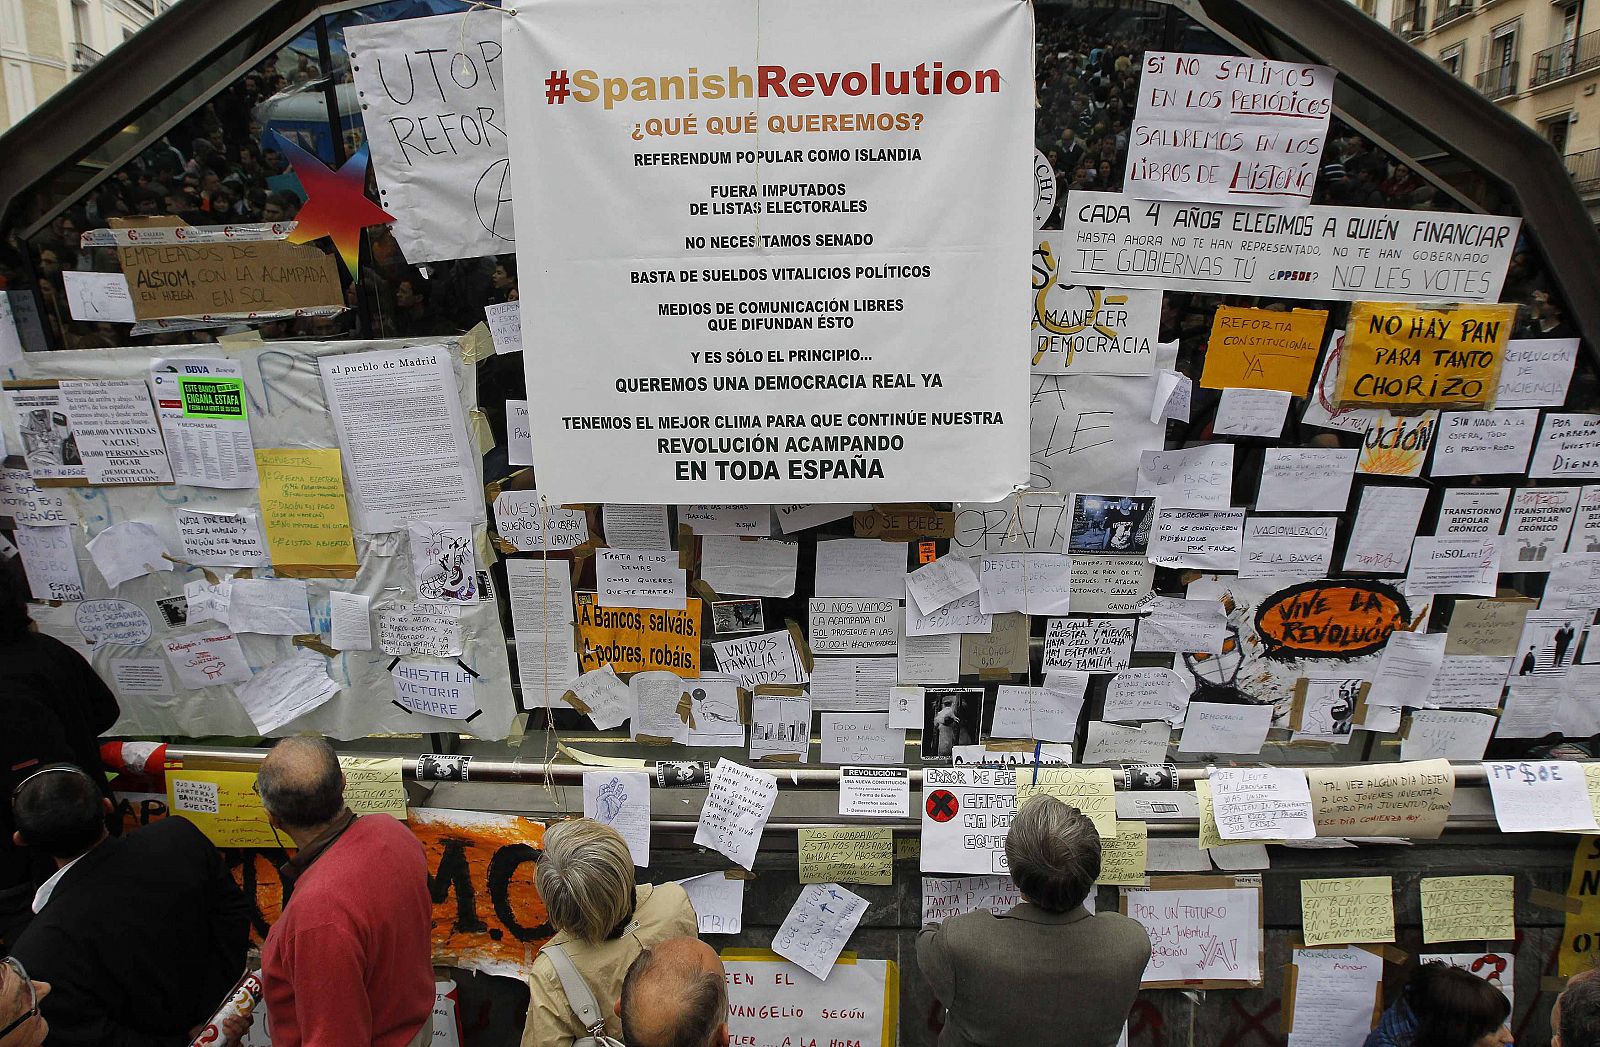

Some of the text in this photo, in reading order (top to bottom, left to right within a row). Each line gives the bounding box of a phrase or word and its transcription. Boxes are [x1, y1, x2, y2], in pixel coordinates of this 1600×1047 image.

[1175, 57, 1200, 76] NO
[545, 62, 1001, 110] #SpanishRevolution
[1151, 88, 1176, 108] EN
[1186, 89, 1222, 110] LOS
[631, 112, 924, 141] ¿QUÉ QUÉ QUEREMOS?
[1135, 126, 1320, 155] SALDREMOS EN LOS
[634, 148, 922, 167] REFERENDUM POPULAR COMO ISLANDIA
[1197, 165, 1219, 184] DE
[710, 183, 846, 198] FUERA IMPUTADOS
[689, 200, 868, 216] DE LISTAS ELECTORALES
[1078, 204, 1510, 249] CADA 4 AÑOS ELEGIMOS A QUIÉN FINANCIAR
[685, 235, 706, 249] NO
[815, 233, 874, 247] SENADO
[1077, 231, 1116, 244] HASTA
[1123, 232, 1163, 246] AHORA
[1172, 235, 1188, 247] NO
[1192, 235, 1204, 248] TE
[1210, 239, 1233, 250] HAN
[1333, 247, 1348, 258] NO
[1358, 248, 1370, 259] TE
[1379, 248, 1401, 259] HAN
[1413, 250, 1489, 264] GOBERNADO
[227, 245, 258, 258] DE
[198, 266, 228, 282] CON
[236, 266, 253, 281] LA
[262, 264, 328, 282] ACAMPADA
[630, 263, 931, 284] BASTA DE SUELDOS VITALICIOS POLÍTICOS
[1078, 249, 1108, 271] TE
[1117, 250, 1223, 277] GOBIERNAS
[1233, 256, 1256, 281] TÚ
[1332, 265, 1365, 289] NO
[1374, 267, 1411, 290] LES
[1423, 267, 1491, 294] VOTES
[658, 297, 904, 316] MEDIOS DE COMUNICACIÓN LIBRES
[707, 313, 855, 332] QUE DIFUNDAN ÉSTO
[1031, 310, 1127, 327] AMANECER
[1221, 317, 1292, 332] REFORMA
[1370, 315, 1500, 344] NO HAY PAN
[1037, 336, 1151, 353] DEMOCRACIA
[1224, 335, 1316, 351] CONSTITUCIONAL
[690, 350, 701, 364] Y
[704, 350, 722, 364] ES
[725, 347, 765, 363] SÓLO
[769, 349, 784, 362] EL
[1376, 347, 1493, 369] PARA TANTO
[185, 366, 209, 374] BBVA
[331, 355, 437, 377] al pueblo de Madrid
[1243, 352, 1264, 380] YA
[615, 372, 943, 393] QUEREMOS UNA DEMOCRACIA REAL YA
[562, 411, 1004, 430] TENEMOS EL MEJOR CLIMA PARA QUE CONTINÚE NUESTRA
[657, 434, 905, 454] REVOLUCIÓN ACAMPANDO
[674, 455, 884, 481] EN TODA ESPAÑA
[853, 517, 874, 531] NO
[882, 515, 898, 530] SE
[1448, 524, 1488, 532] CRÓNICO
[1249, 552, 1323, 562] DE LA BANCA
[810, 602, 893, 612] NO NOS VAMOS
[1350, 591, 1382, 614] LA
[581, 605, 697, 637] A Bancos, salváis.
[582, 638, 696, 669] A pobres, robáis.
[725, 637, 777, 657] UNIDOS
[398, 666, 471, 683] HASTA LA
[398, 682, 459, 698] VICTORIA
[402, 696, 458, 715] SIEMPRE
[848, 769, 896, 777] REVOLUCIÓN
[926, 769, 989, 784] ERROR DE
[1420, 773, 1449, 785] DEJEN
[1134, 903, 1227, 920] POR FUTURO
[821, 1007, 865, 1020] SEGÚN
